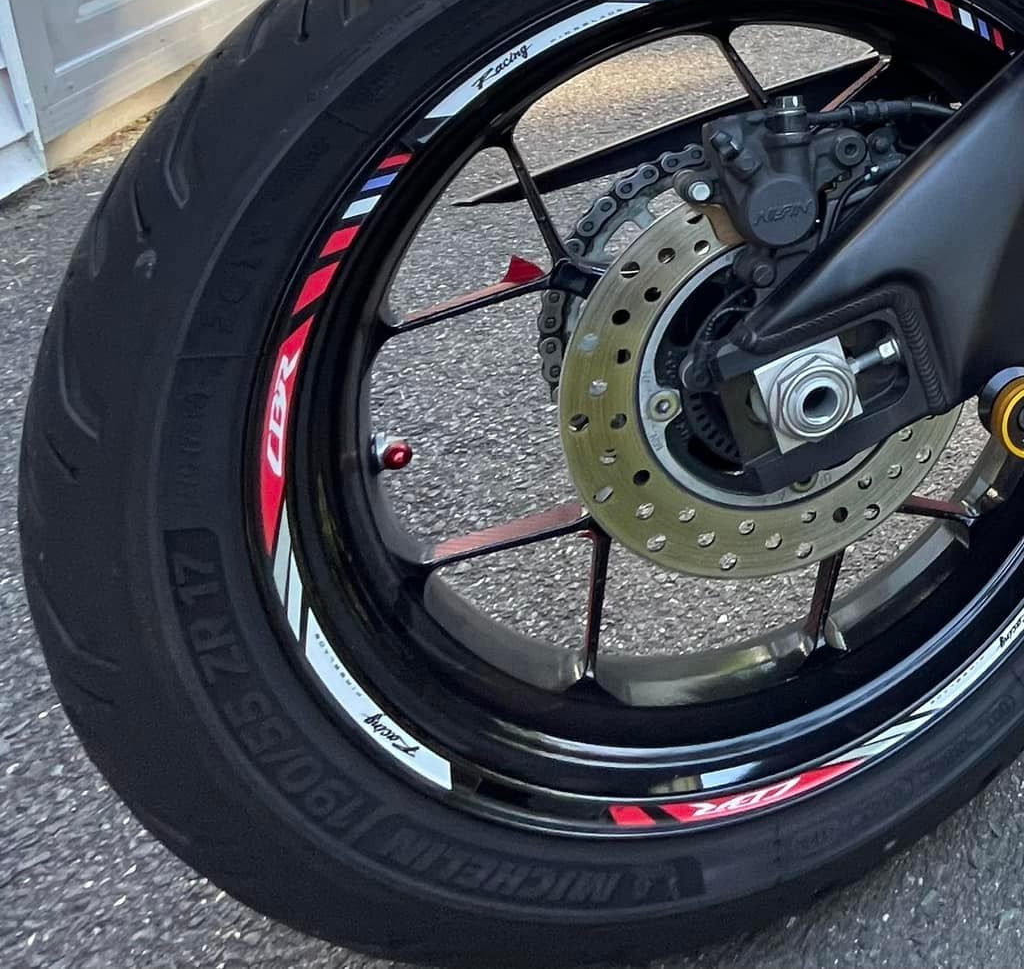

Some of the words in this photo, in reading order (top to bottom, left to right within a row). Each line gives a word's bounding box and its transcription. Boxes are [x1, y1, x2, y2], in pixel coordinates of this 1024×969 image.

[471, 43, 533, 90] Racing
[266, 347, 301, 477] CBR
[362, 713, 420, 758] Racing
[690, 775, 801, 816] CBR
[380, 828, 620, 903] MICHELIN
